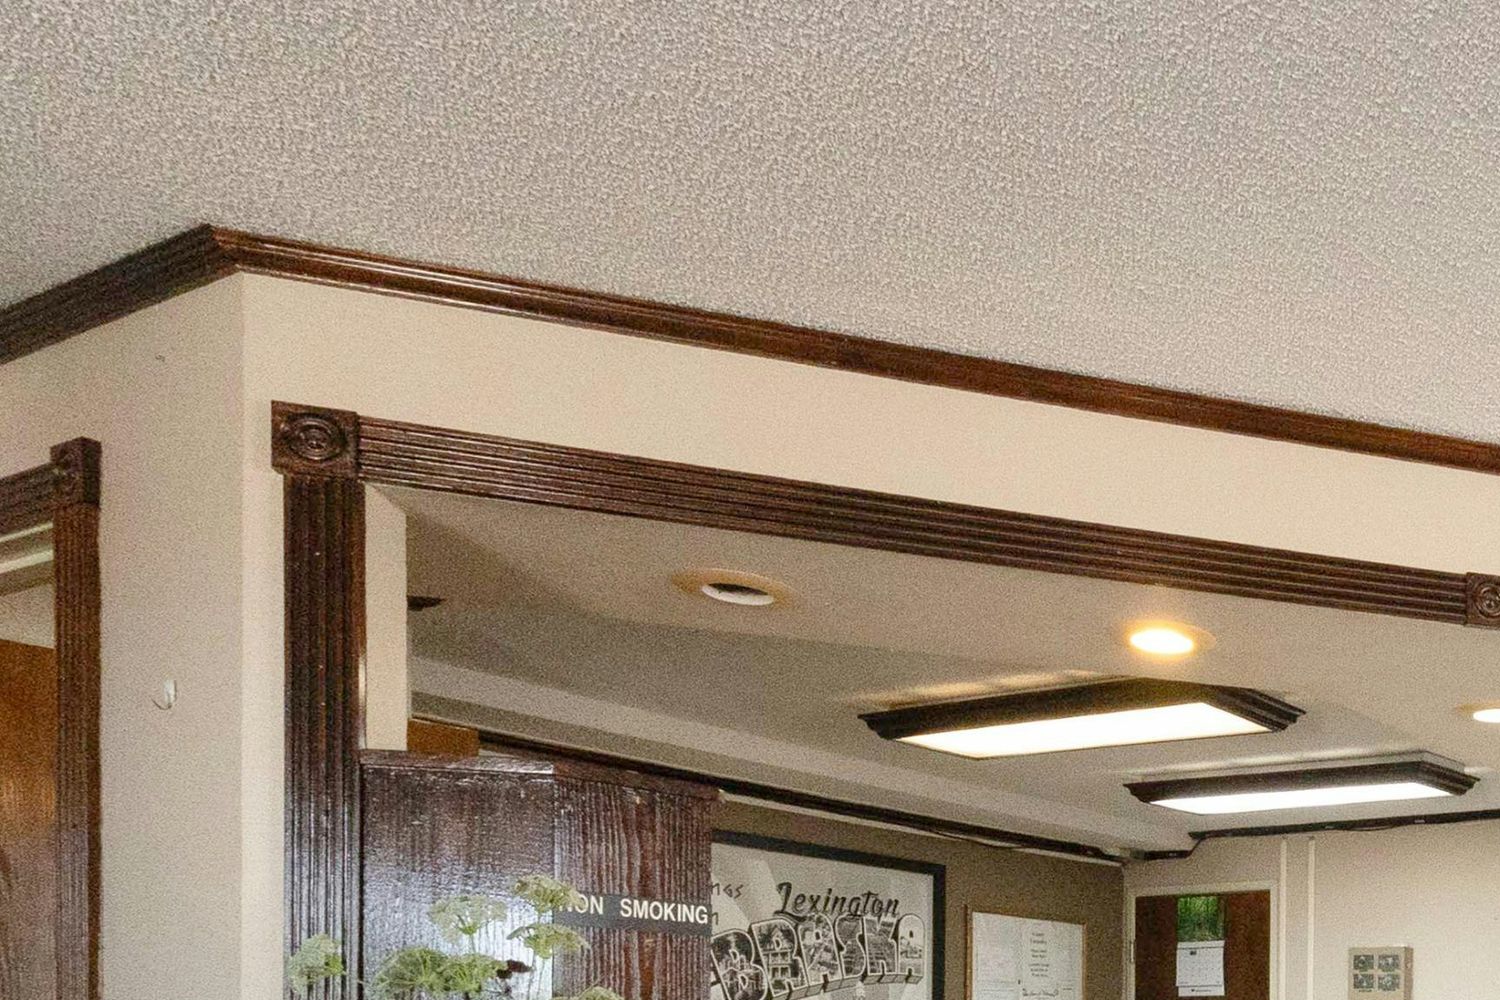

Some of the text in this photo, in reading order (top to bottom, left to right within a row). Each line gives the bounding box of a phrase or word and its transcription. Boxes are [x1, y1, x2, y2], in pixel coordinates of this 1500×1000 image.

[557, 894, 604, 915] ON
[620, 898, 709, 924] SMOKING
[773, 881, 900, 921] Lexington
